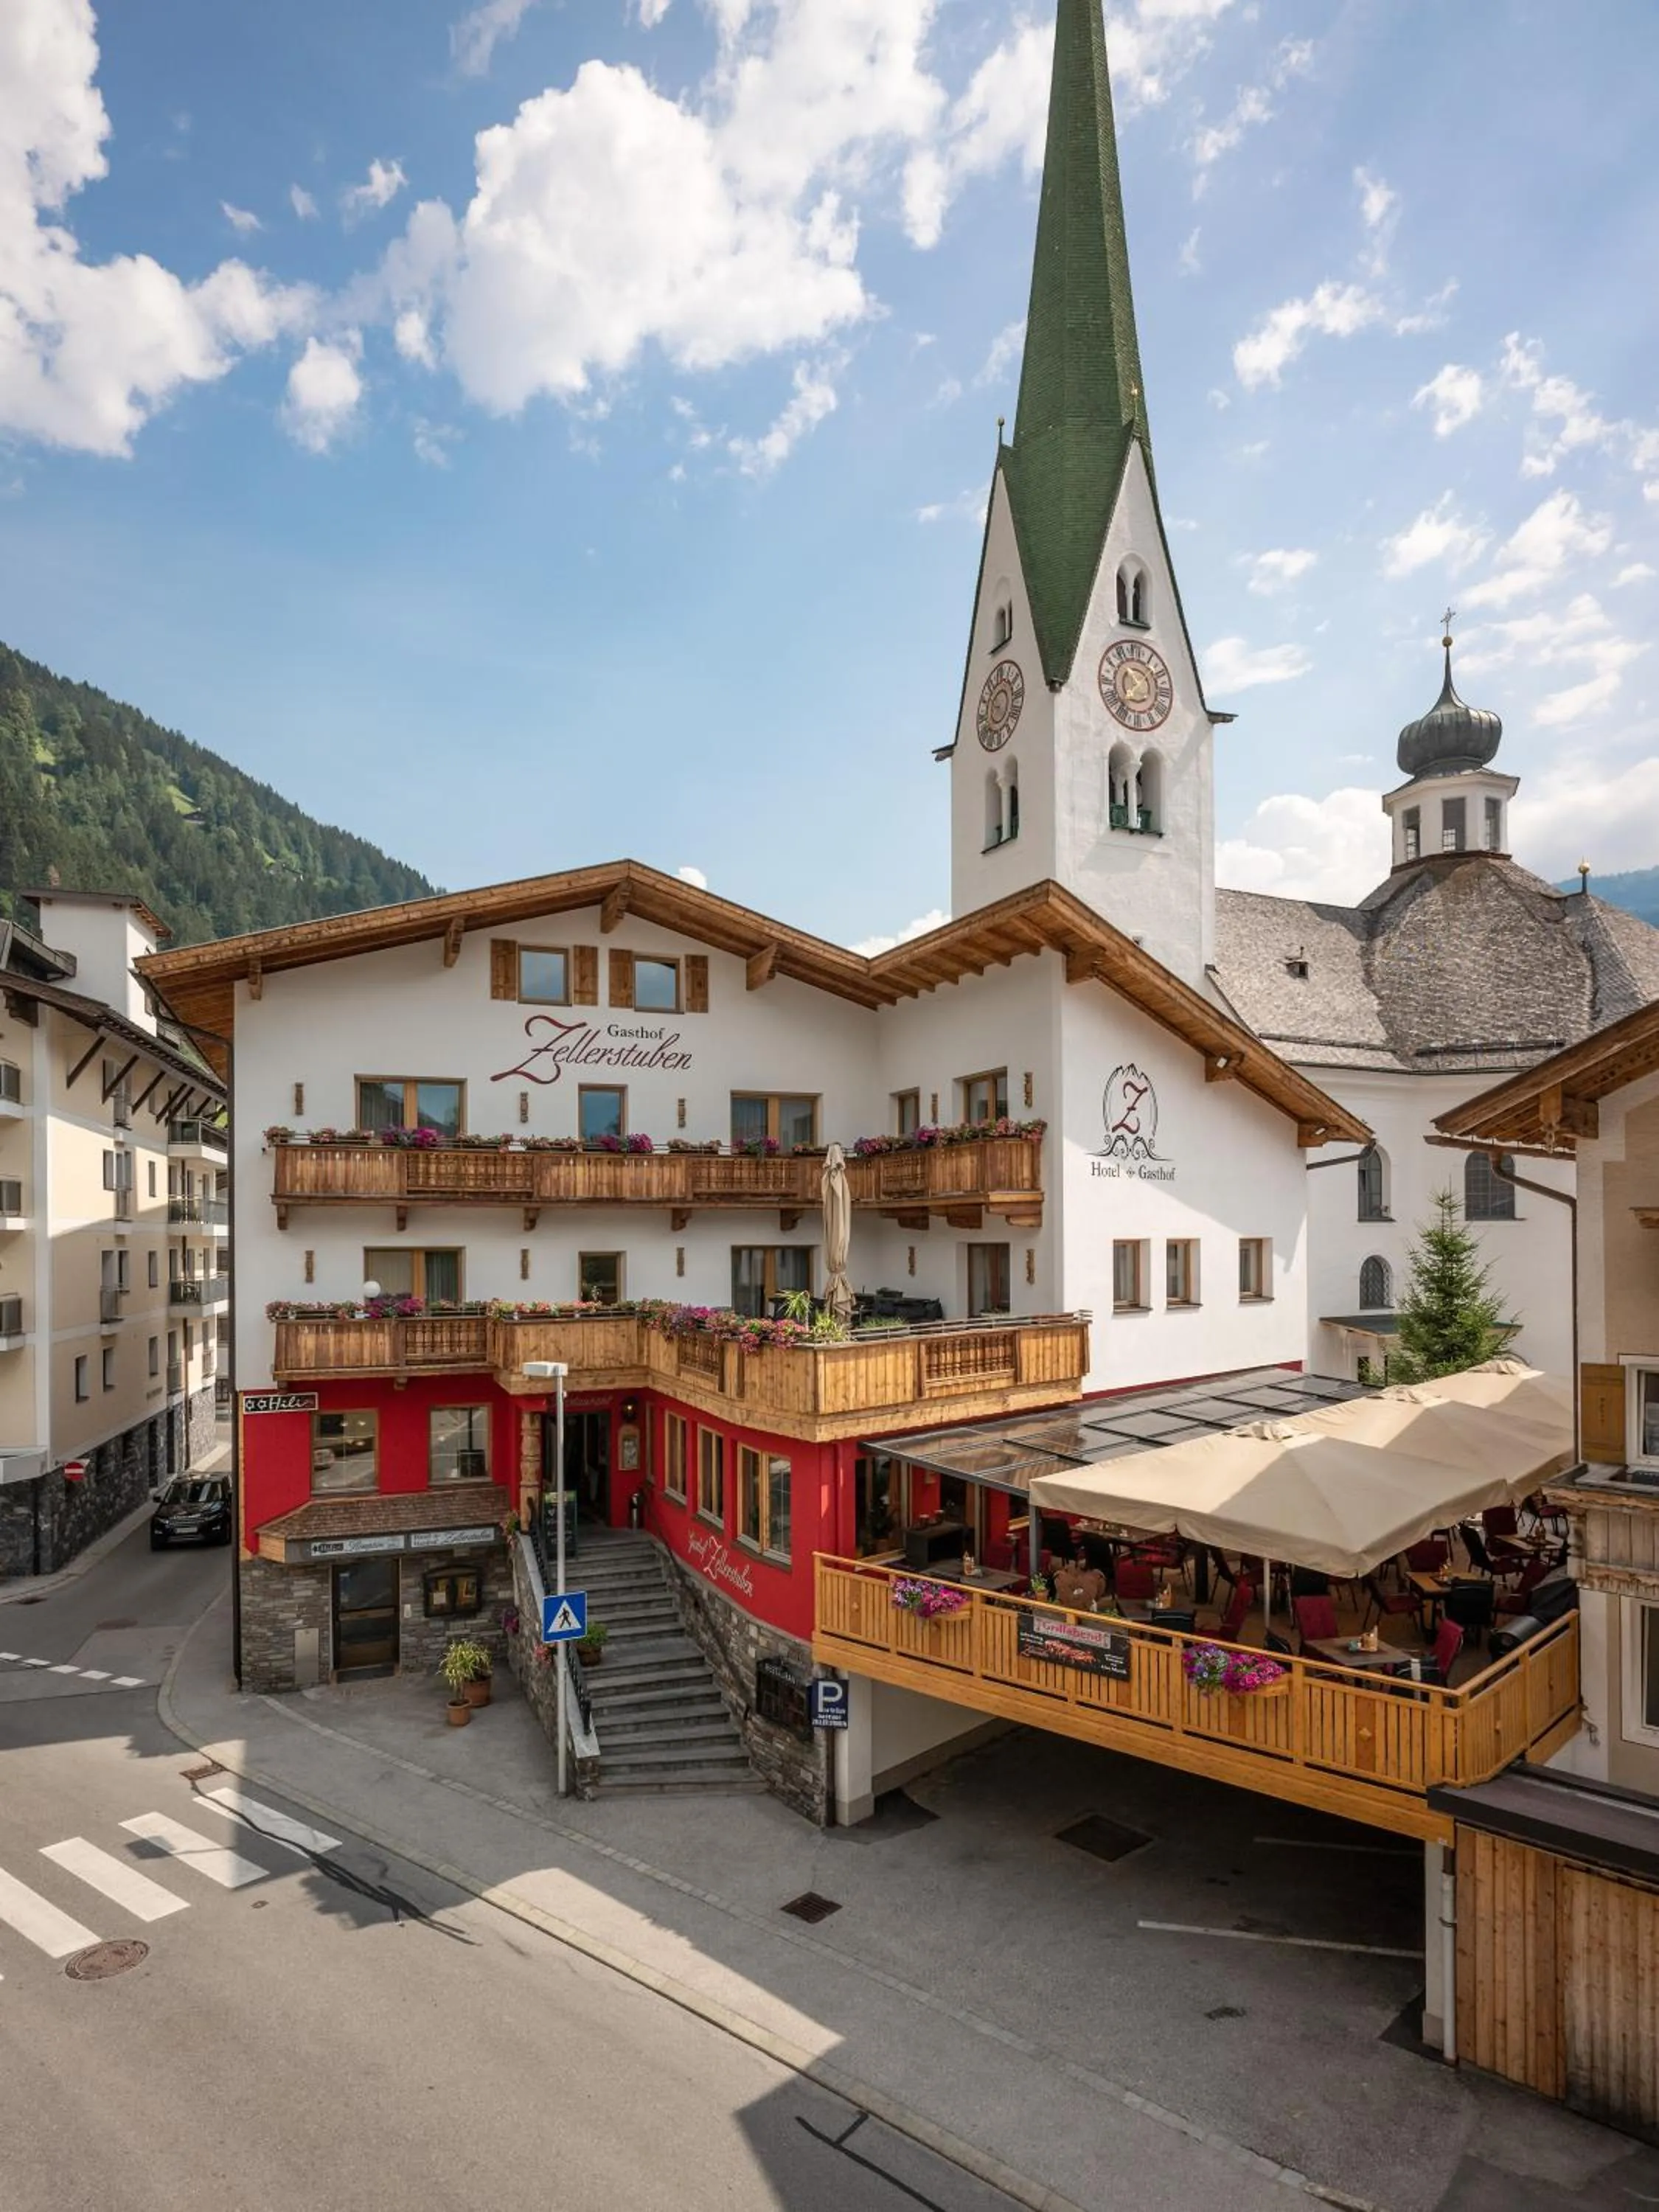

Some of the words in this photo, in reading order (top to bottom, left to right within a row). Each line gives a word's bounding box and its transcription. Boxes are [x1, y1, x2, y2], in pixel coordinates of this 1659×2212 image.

[608, 1023, 665, 1040] Gasthof
[490, 1015, 692, 1085] Zellerstuben
[1091, 1161, 1120, 1178] Hotel
[1138, 1164, 1176, 1180] Gasthof
[818, 1681, 843, 1712] P
